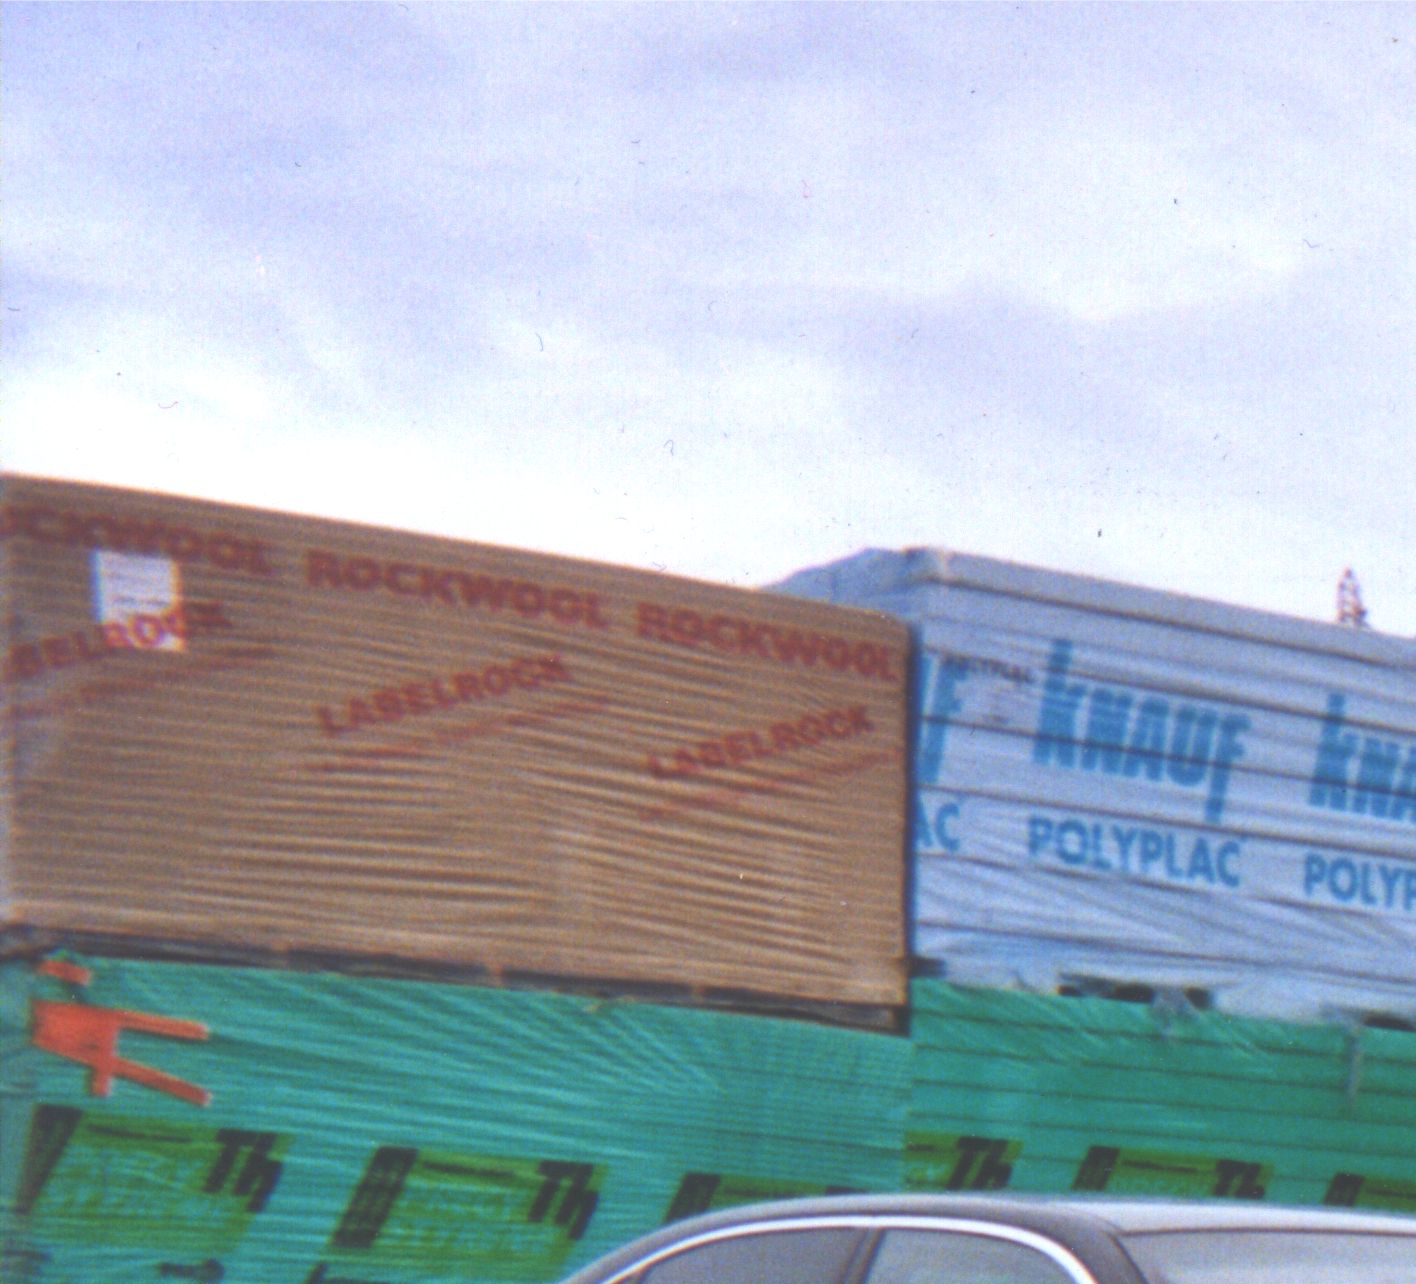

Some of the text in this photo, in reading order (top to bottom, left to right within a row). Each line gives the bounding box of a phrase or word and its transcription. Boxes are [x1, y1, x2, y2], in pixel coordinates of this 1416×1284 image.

[305, 548, 610, 630] ROCKWOOL
[637, 602, 900, 682] ROCKWOOL
[316, 653, 573, 739] LABELROCK
[1028, 814, 1242, 888] POLYPLAC
